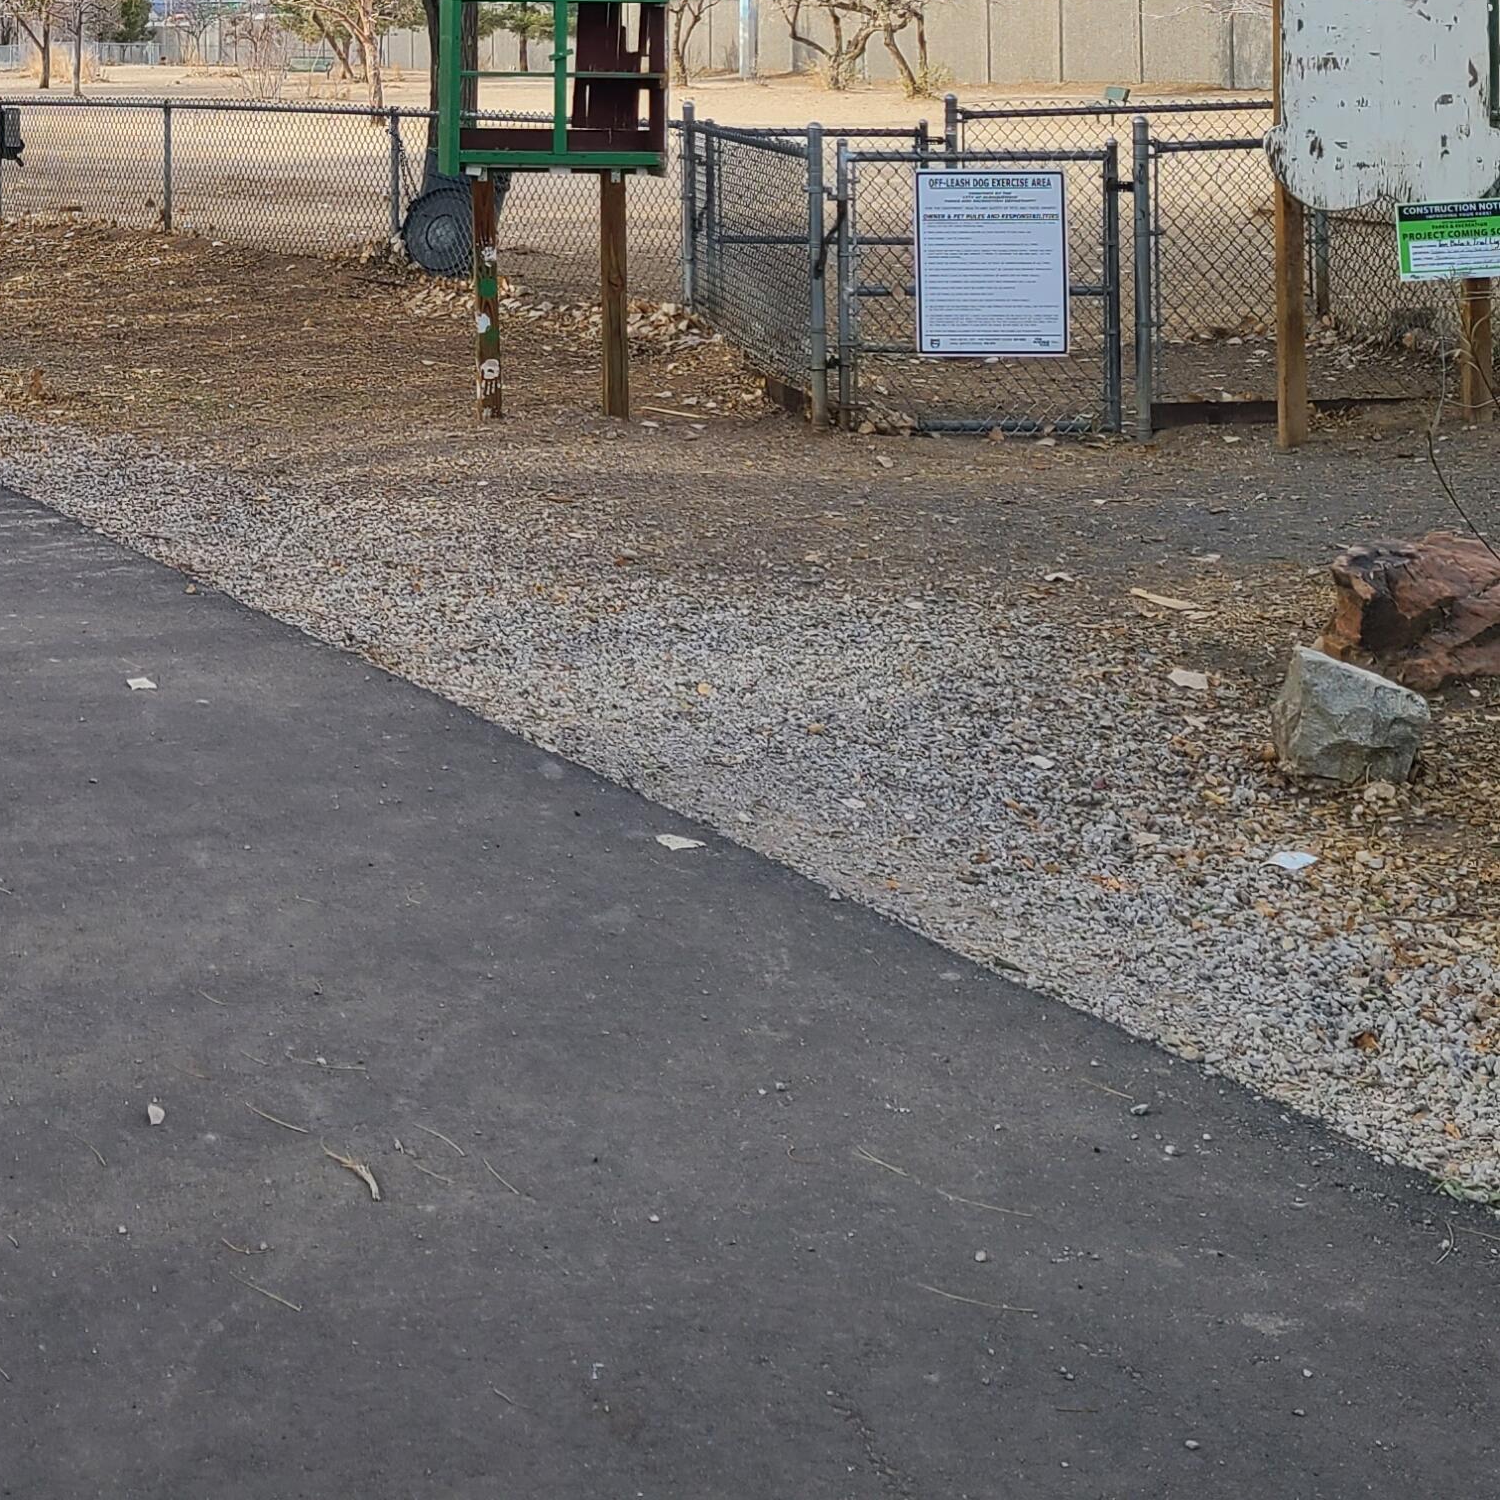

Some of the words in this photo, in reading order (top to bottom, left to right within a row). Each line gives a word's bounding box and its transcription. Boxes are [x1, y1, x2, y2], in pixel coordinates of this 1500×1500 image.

[928, 178, 970, 188] OFF-LEASH
[972, 178, 989, 187] DOG
[991, 178, 1029, 187] EXERCISE
[1031, 178, 1052, 187] AREA
[1403, 203, 1476, 215] CONSTRUCTION
[1402, 231, 1445, 241] PROJECT
[1448, 229, 1488, 239] COMING
